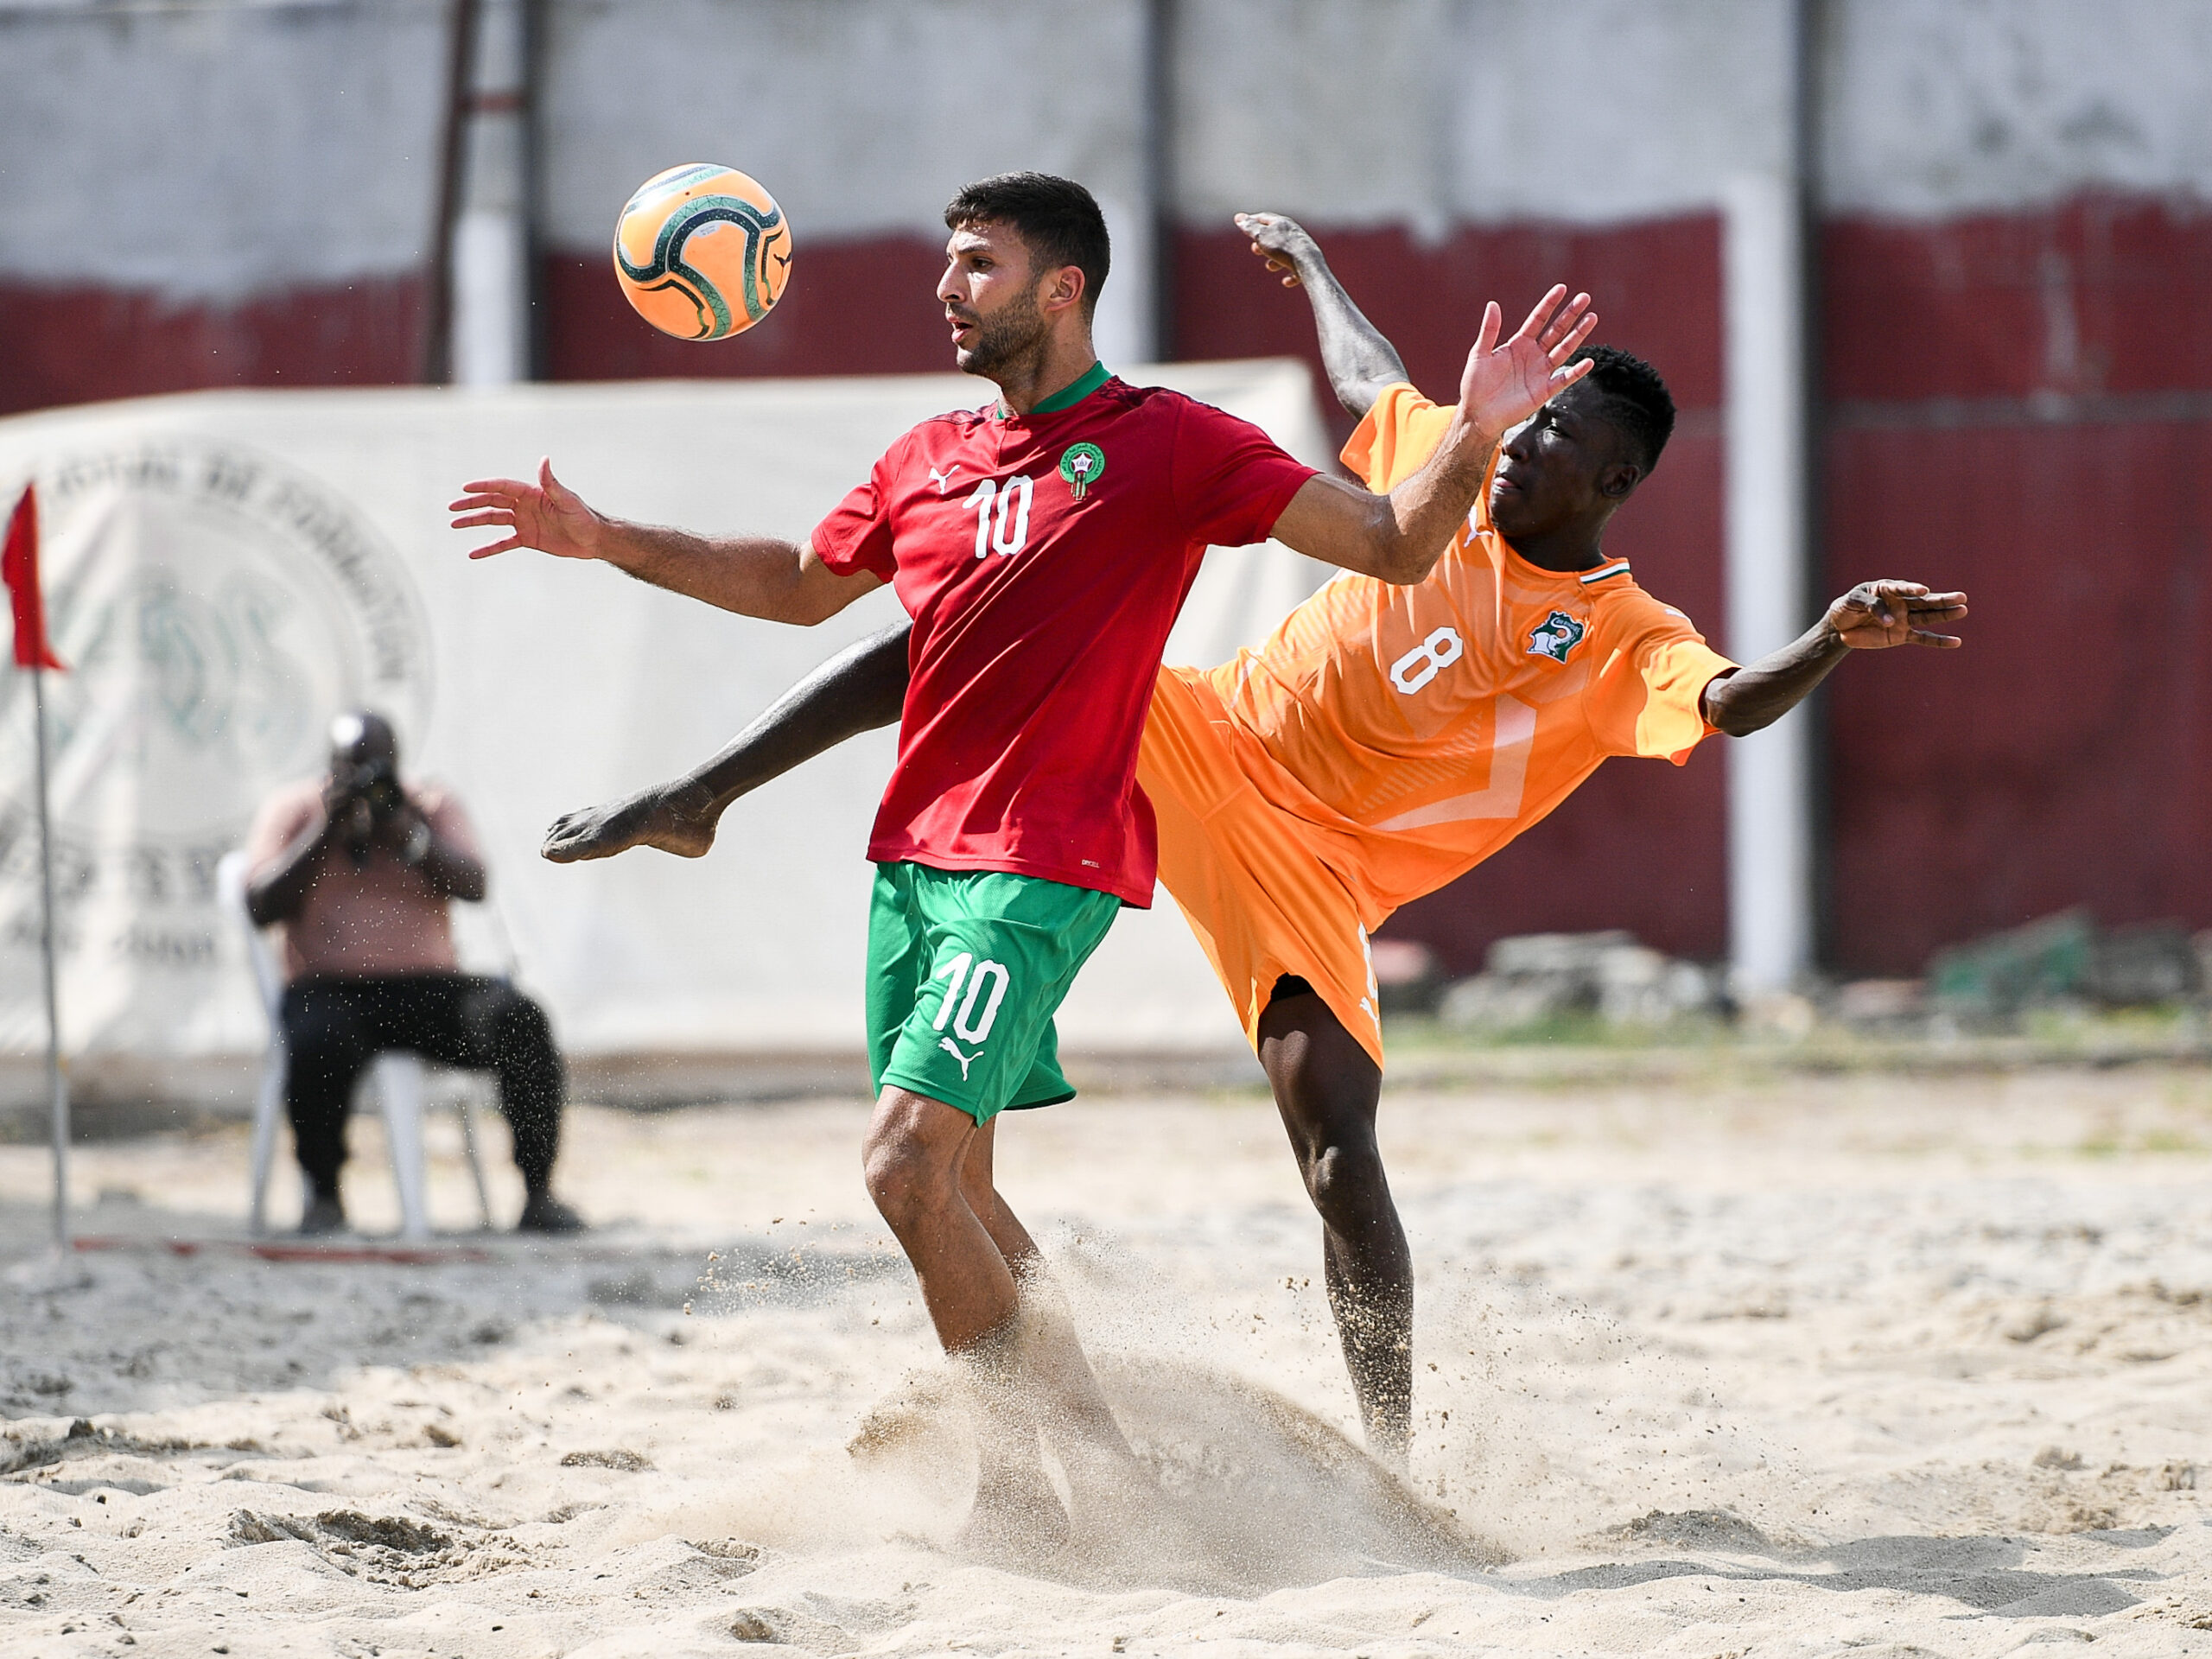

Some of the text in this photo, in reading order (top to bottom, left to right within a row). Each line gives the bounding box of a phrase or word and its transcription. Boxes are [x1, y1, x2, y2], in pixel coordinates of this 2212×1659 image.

[962, 474, 1034, 559] 10
[1389, 626, 1464, 695] 8
[933, 952, 1010, 1045] 10
